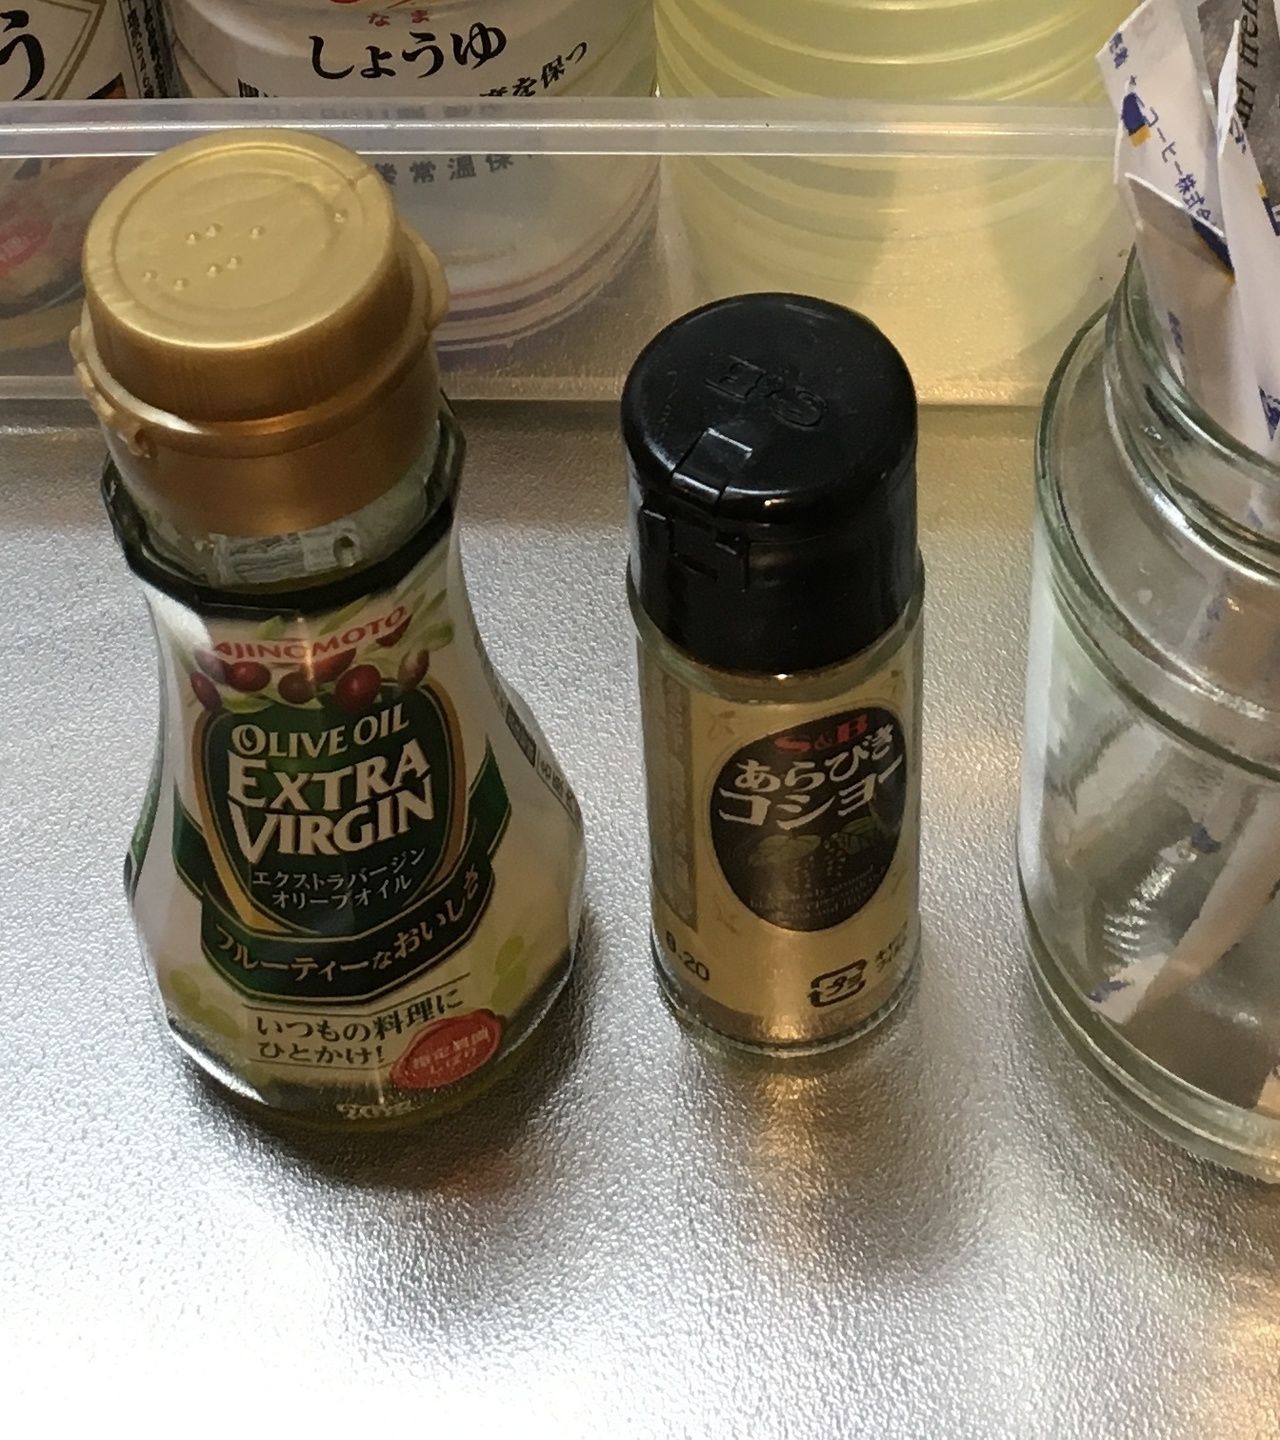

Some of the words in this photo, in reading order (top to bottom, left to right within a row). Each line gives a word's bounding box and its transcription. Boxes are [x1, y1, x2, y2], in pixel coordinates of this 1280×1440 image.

[368, 9, 430, 27] なま
[308, 20, 508, 81] しょうゆ
[214, 606, 408, 659] AJINOMOTO
[231, 724, 349, 758] OLIVE
[353, 702, 410, 746] OIL
[734, 723, 895, 793] あらびき
[227, 738, 431, 810] EXTRA
[718, 753, 904, 831] コショー
[227, 774, 435, 864] VIRGIN
[252, 847, 426, 891] エクストラバージン
[257, 988, 465, 1042] いつもの料理に
